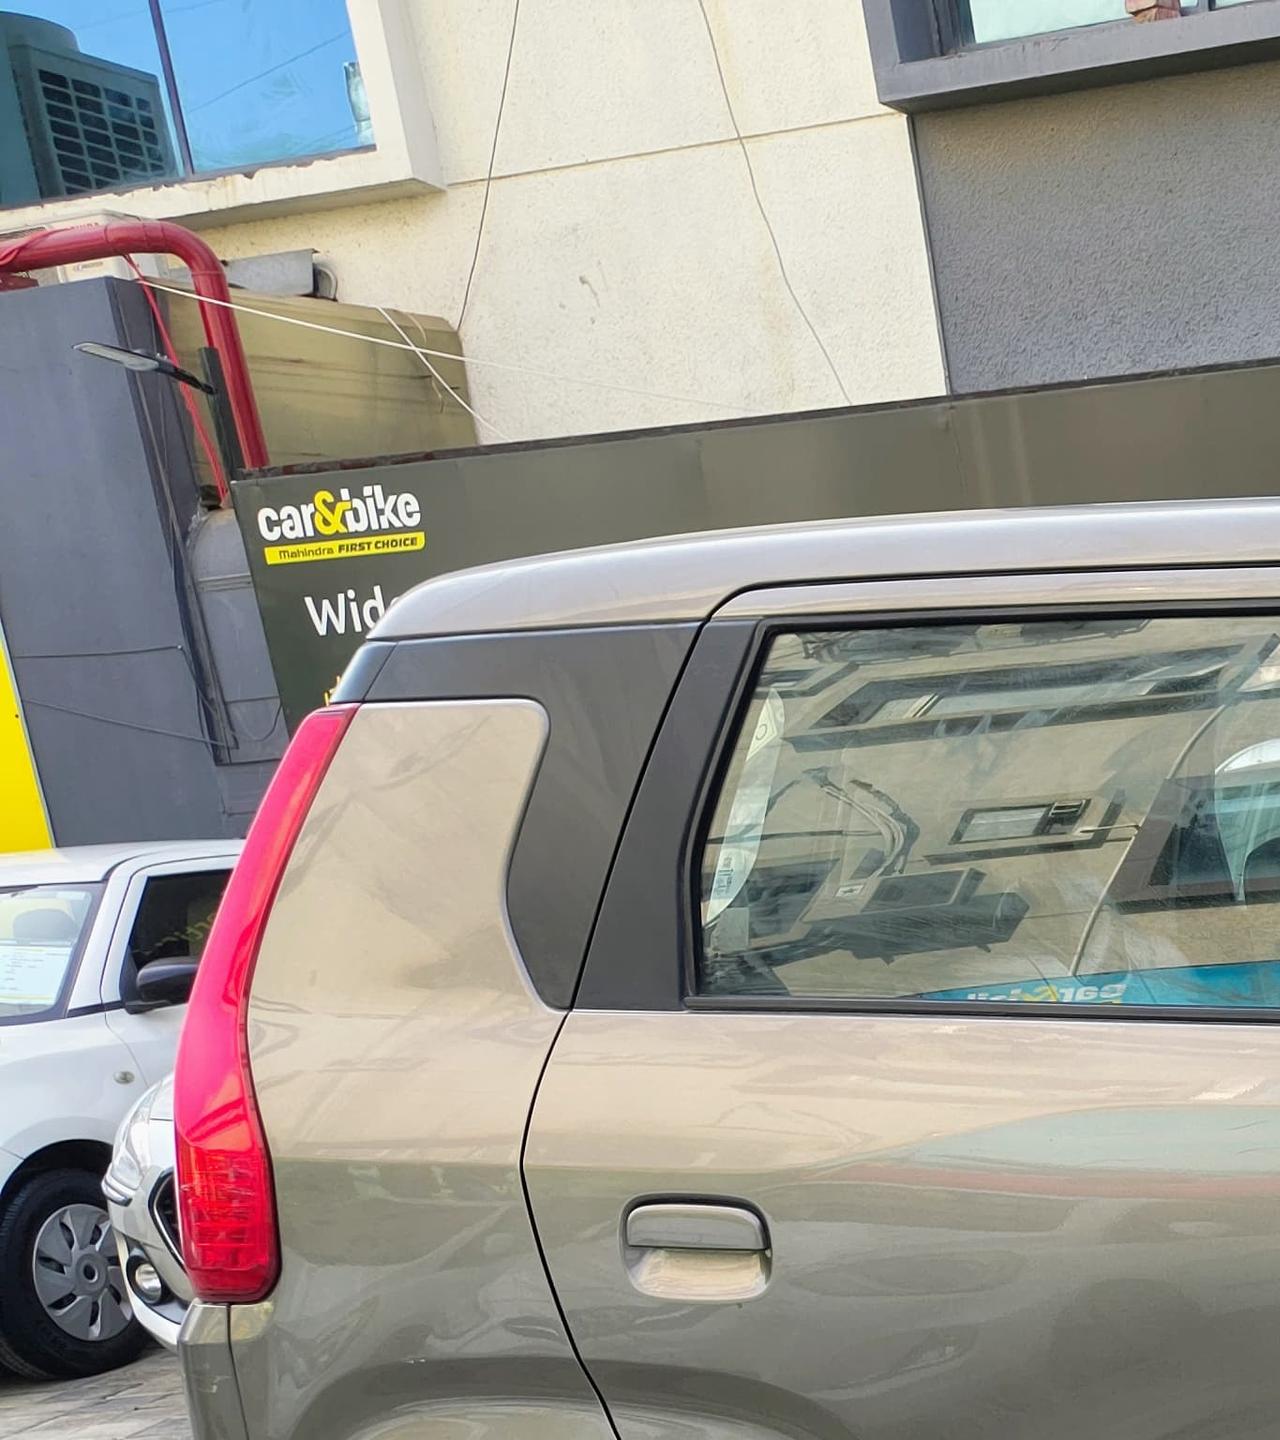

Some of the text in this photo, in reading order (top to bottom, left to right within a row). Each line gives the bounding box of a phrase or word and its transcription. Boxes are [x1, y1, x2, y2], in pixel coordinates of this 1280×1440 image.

[258, 484, 421, 541] car&bike
[279, 536, 418, 560] Mahindra FIRST CHOICE
[304, 585, 400, 636] Wid
